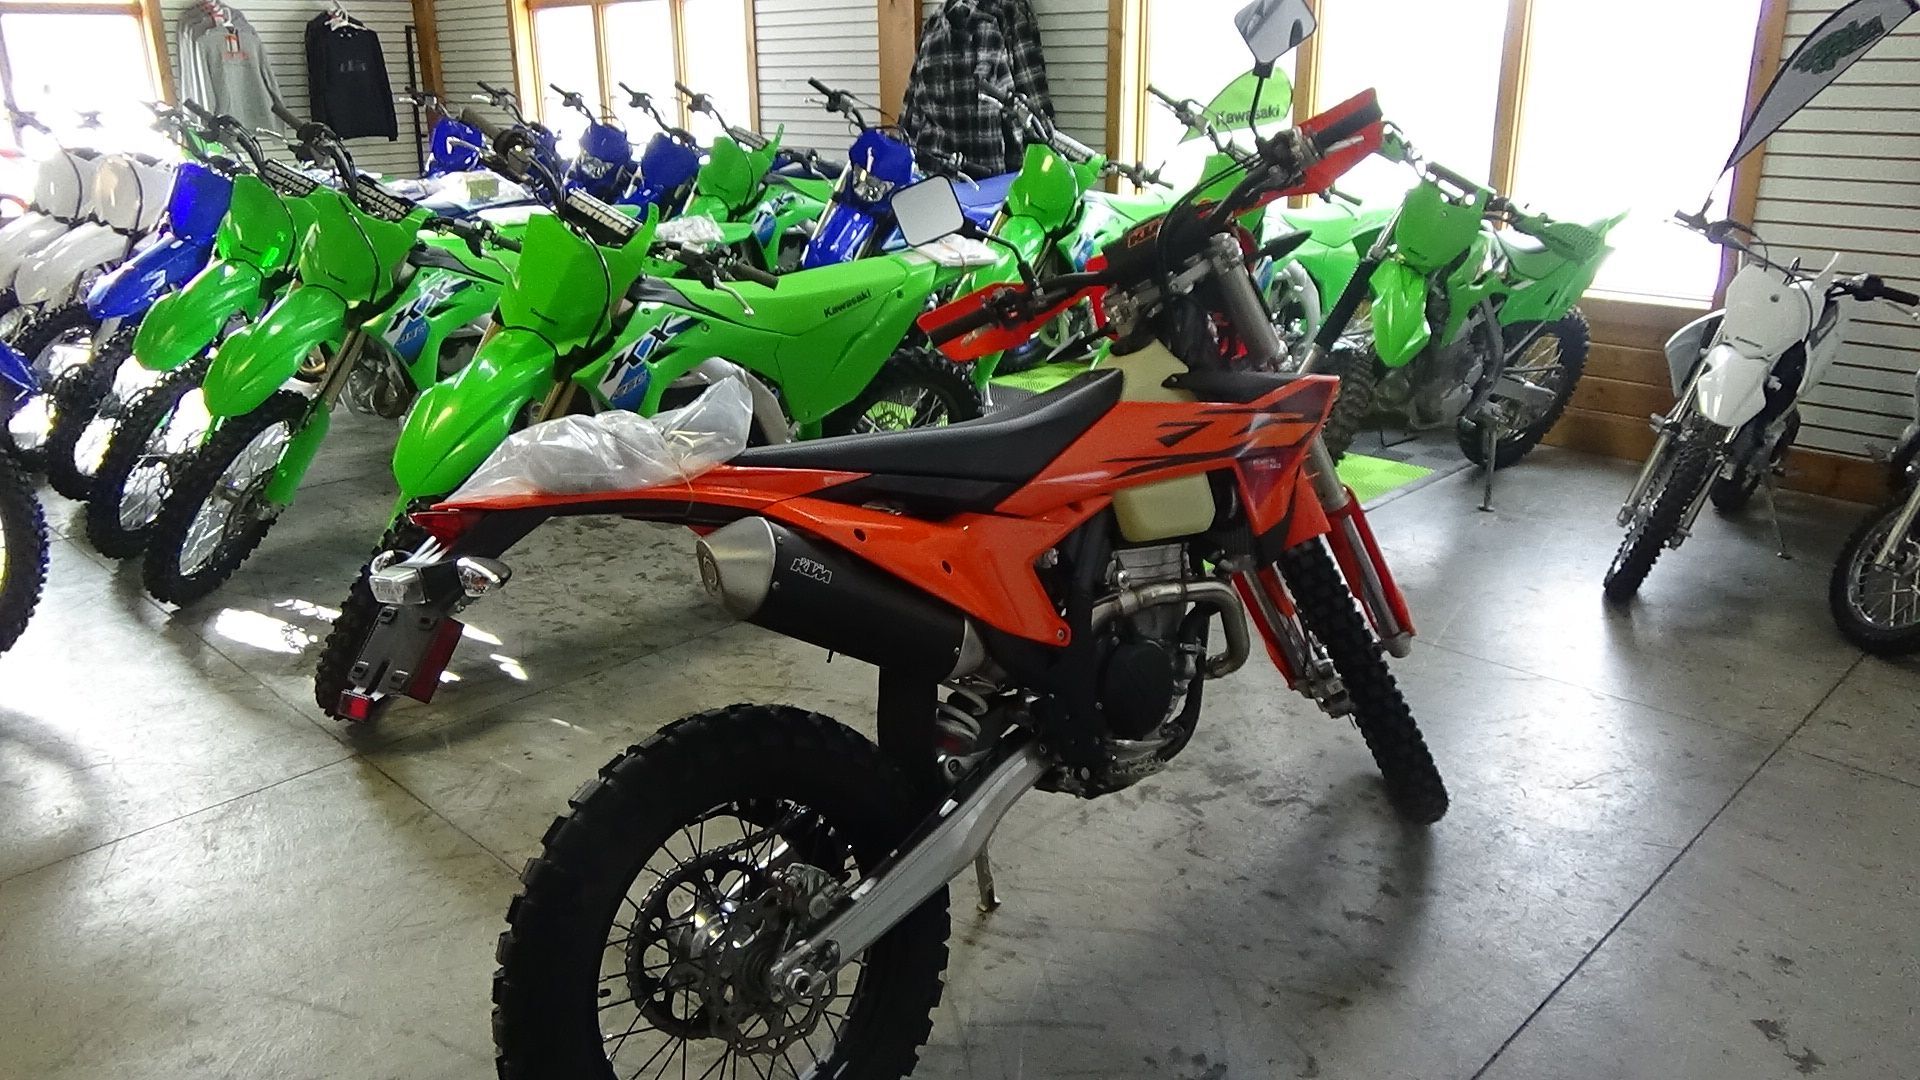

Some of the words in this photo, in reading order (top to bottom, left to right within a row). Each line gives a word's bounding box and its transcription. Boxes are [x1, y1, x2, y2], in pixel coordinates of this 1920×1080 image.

[566, 195, 630, 236] RENTHAL
[823, 288, 872, 319] Kawasaki
[602, 312, 697, 385] KX
[790, 557, 832, 584] KTM
